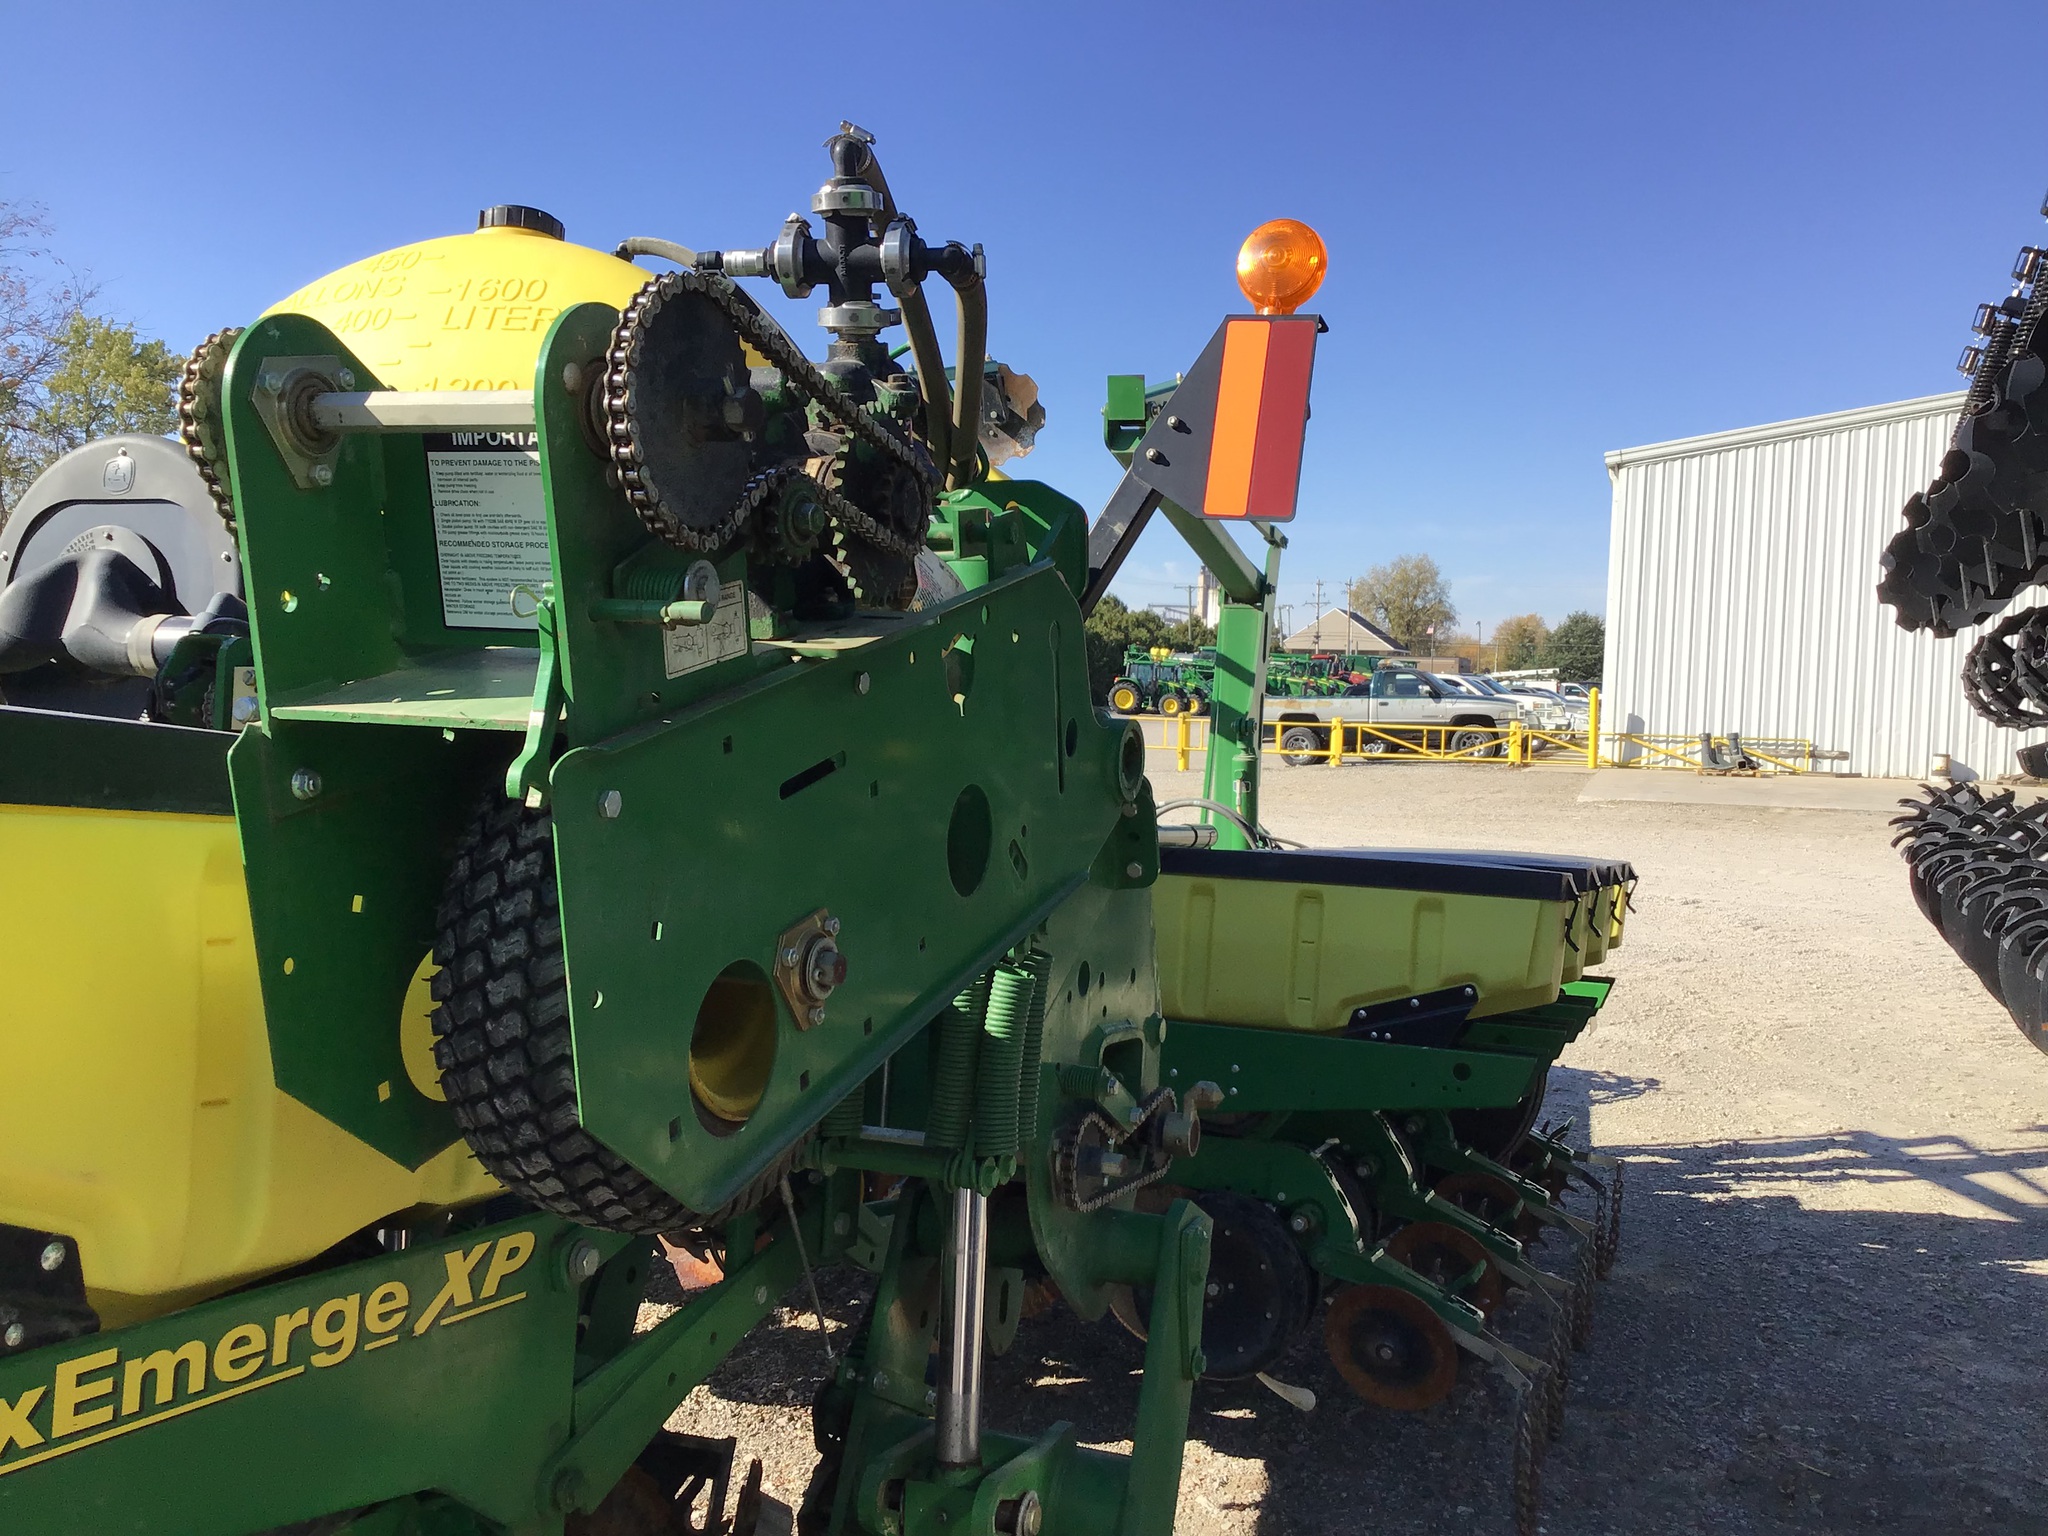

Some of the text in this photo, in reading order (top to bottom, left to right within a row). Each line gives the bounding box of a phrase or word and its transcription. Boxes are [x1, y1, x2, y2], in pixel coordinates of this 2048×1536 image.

[366, 251, 422, 273] 450
[279, 275, 406, 313] ALLONS
[457, 277, 548, 302] 1600
[335, 307, 392, 334] 400
[430, 459, 440, 467] TO
[441, 459, 472, 467] PREVENT
[473, 459, 502, 467] DAMAGE
[503, 459, 513, 467] TO
[514, 459, 528, 467] THE
[434, 499, 481, 507] LUBRICATION:
[439, 540, 491, 548] RECOMMENDED
[413, 1231, 535, 1337] XP
